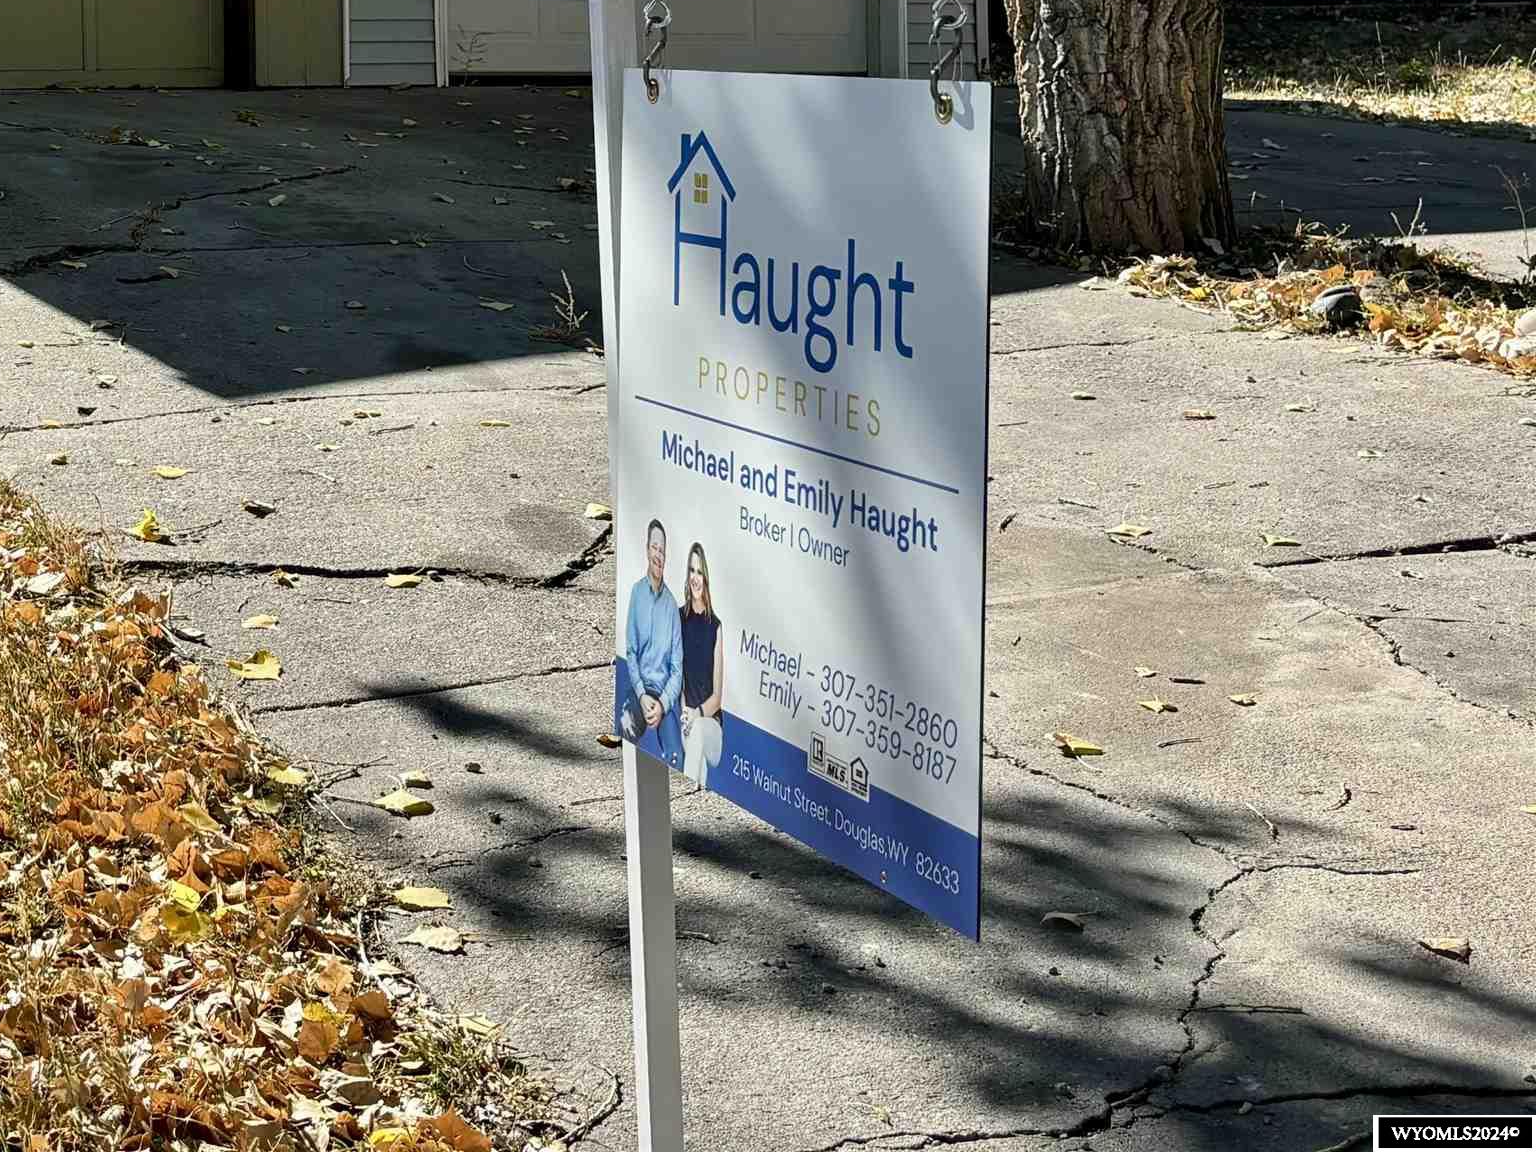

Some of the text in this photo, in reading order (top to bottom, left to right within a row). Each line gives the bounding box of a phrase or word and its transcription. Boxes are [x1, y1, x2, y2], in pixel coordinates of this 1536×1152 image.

[666, 129, 915, 374] Haught
[697, 356, 882, 437] PROPERTIES
[661, 430, 939, 553] Michael and Emily Haught
[739, 505, 787, 547] Broker
[798, 527, 850, 568] Owner
[739, 629, 802, 680] Michael
[820, 665, 959, 749] 307-351-2860
[759, 670, 802, 718] Emily
[820, 700, 958, 785] 307-359-8187
[732, 754, 751, 782] 215
[752, 764, 792, 803] Walnut
[914, 852, 961, 895] 82633
